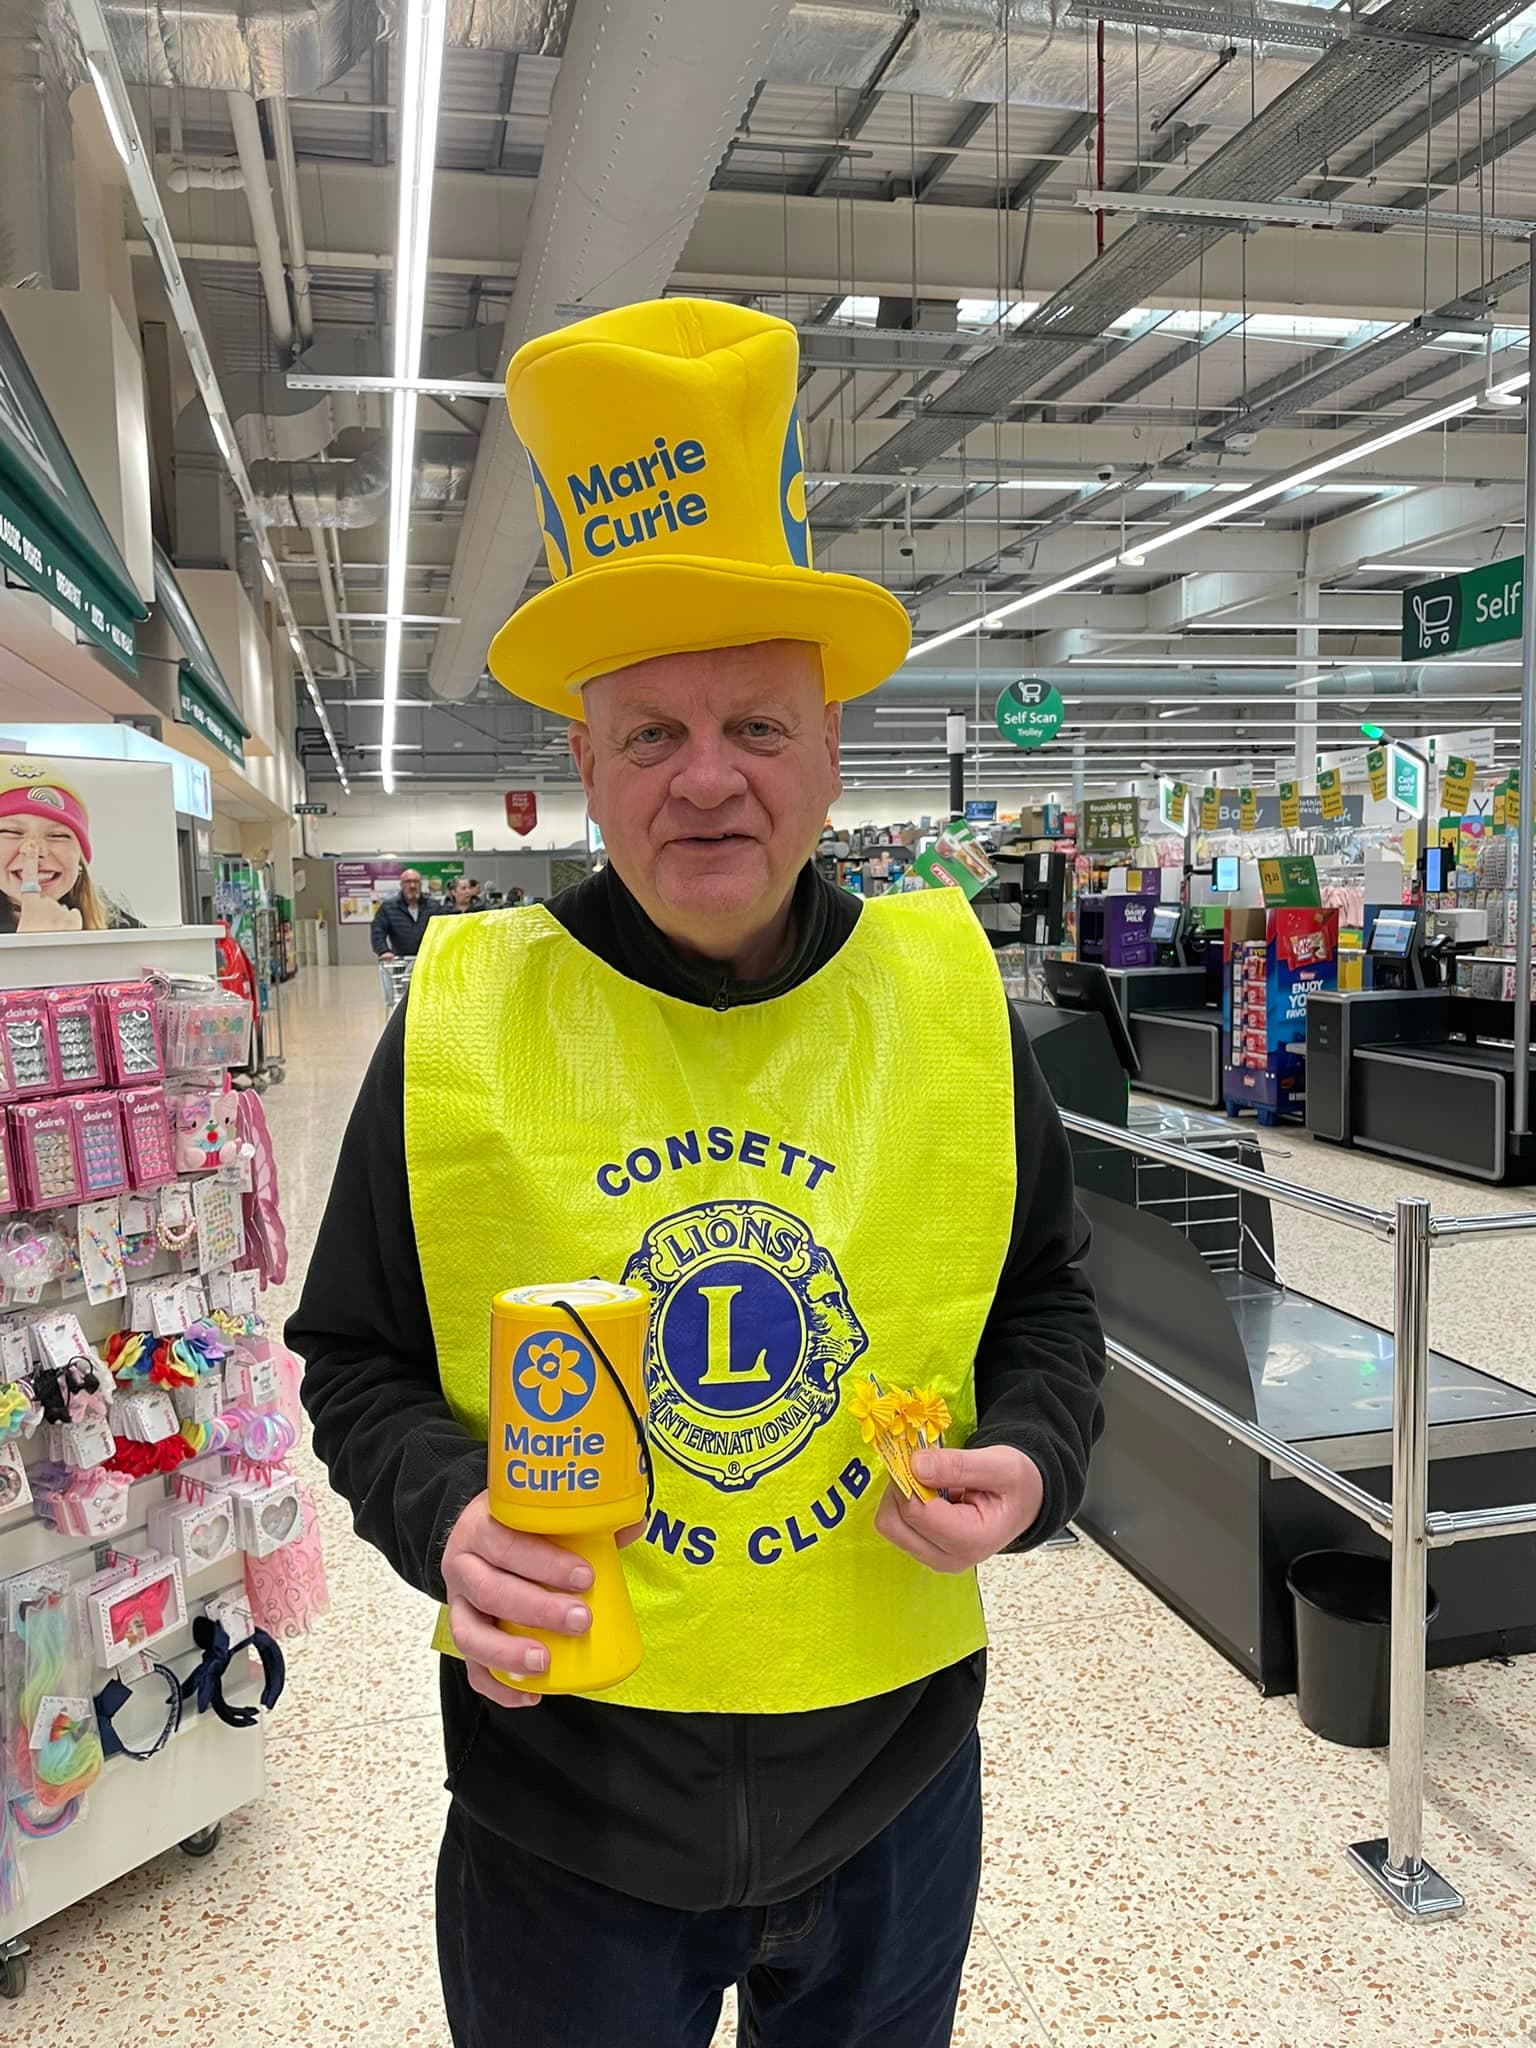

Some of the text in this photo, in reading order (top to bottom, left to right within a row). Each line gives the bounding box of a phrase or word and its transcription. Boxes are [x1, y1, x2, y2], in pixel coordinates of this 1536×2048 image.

[567, 437, 706, 515] Marie
[584, 489, 708, 557] Curie
[1476, 581, 1522, 623] Self
[1003, 711, 1057, 724] Self Scan
[1017, 728, 1043, 738] Trolley
[1219, 805, 1264, 822] Bay
[1289, 995, 1307, 1009] YO
[1291, 980, 1324, 994] ENJOY
[597, 1126, 836, 1197] CONSETT
[664, 1216, 801, 1267] LIONS
[698, 1285, 771, 1385] L
[504, 1423, 605, 1457] Marie
[654, 1390, 815, 1456] INTERNATIONAL
[507, 1460, 599, 1492] Curie
[646, 1509, 716, 1565] NS
[748, 1457, 872, 1565] CLUB
